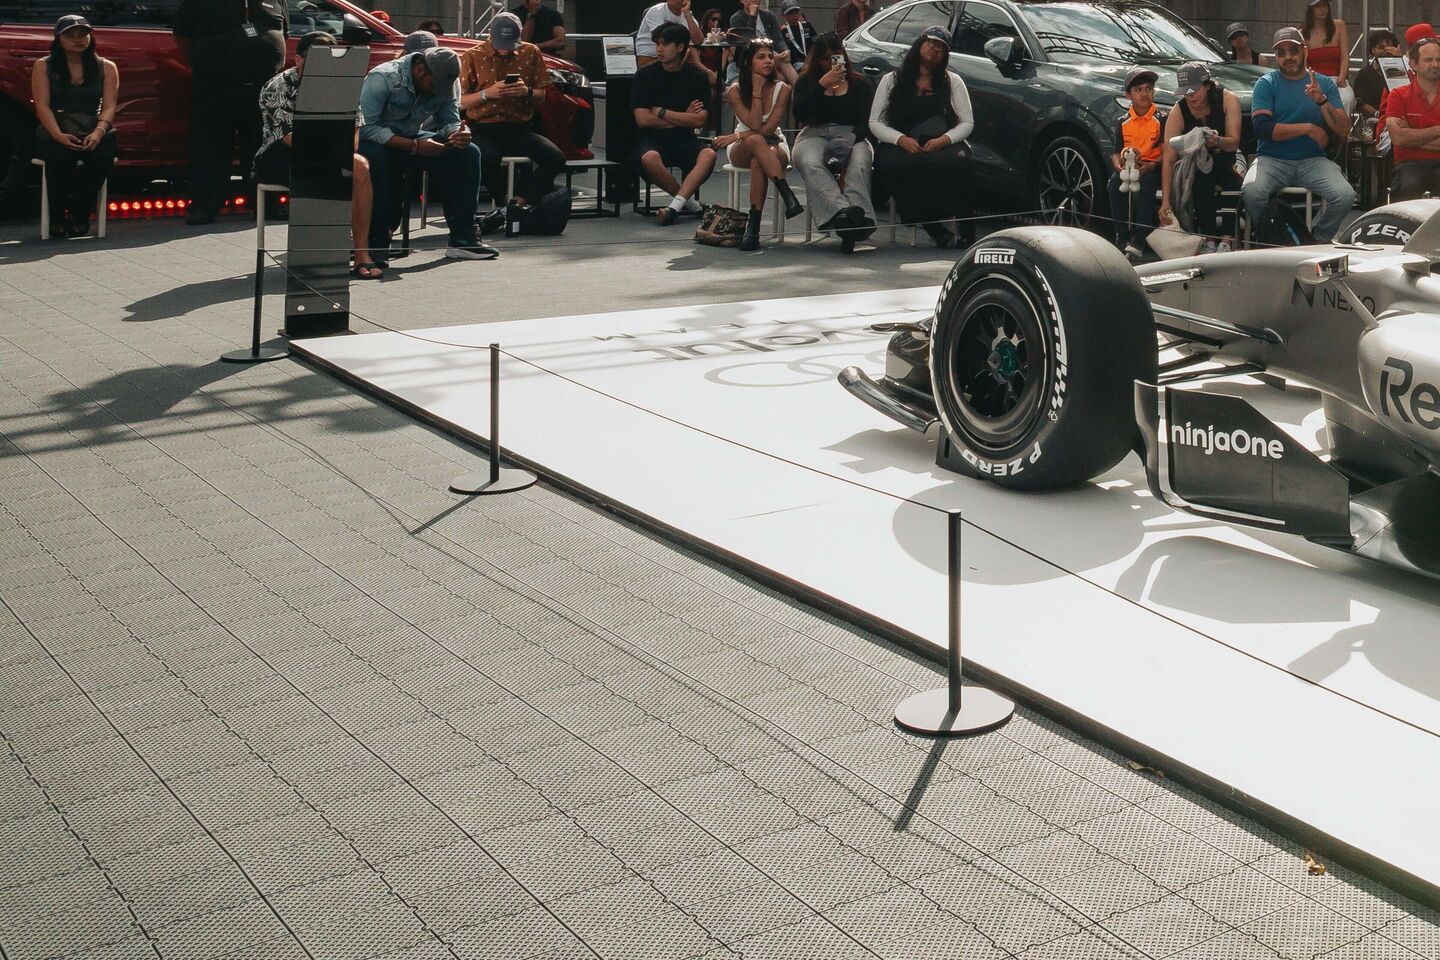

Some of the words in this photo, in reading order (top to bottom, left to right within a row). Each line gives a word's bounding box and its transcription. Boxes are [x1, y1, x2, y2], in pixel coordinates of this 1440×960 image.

[1366, 223, 1411, 244] ZER
[974, 248, 1017, 265] PIRELLI
[1171, 421, 1285, 459] ninjaOne
[961, 448, 1025, 477] ZERO
